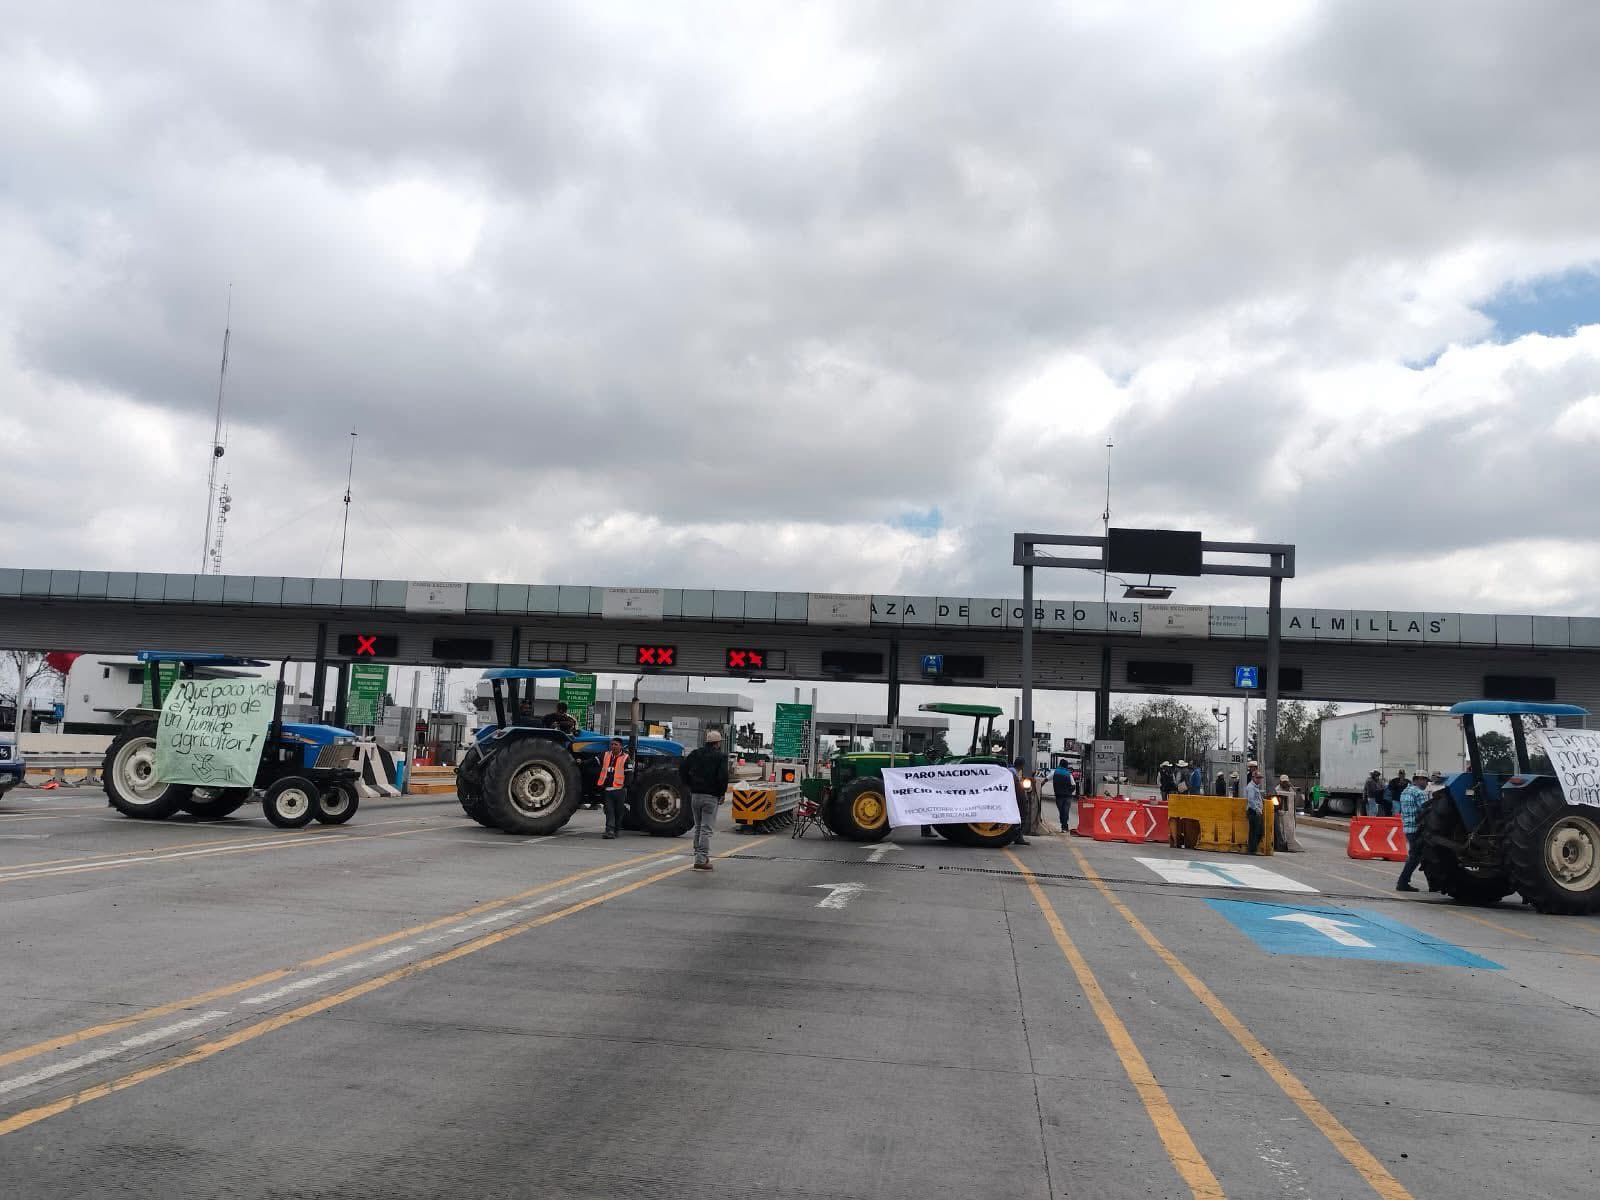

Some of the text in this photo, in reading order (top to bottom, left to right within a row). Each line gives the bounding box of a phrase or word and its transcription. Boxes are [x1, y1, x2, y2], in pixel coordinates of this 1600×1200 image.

[938, 605, 969, 618] DE
[991, 607, 1086, 621] COBRO
[1109, 610, 1140, 623] No.5
[1288, 616, 1447, 633] ALMILLAS"
[210, 684, 245, 703] poco
[169, 696, 262, 718] el trabajo de
[185, 714, 233, 734] humilde
[904, 769, 991, 780] PARO NACIONAL
[892, 787, 933, 796] PRECIO
[983, 783, 1009, 793] MAÍZ
